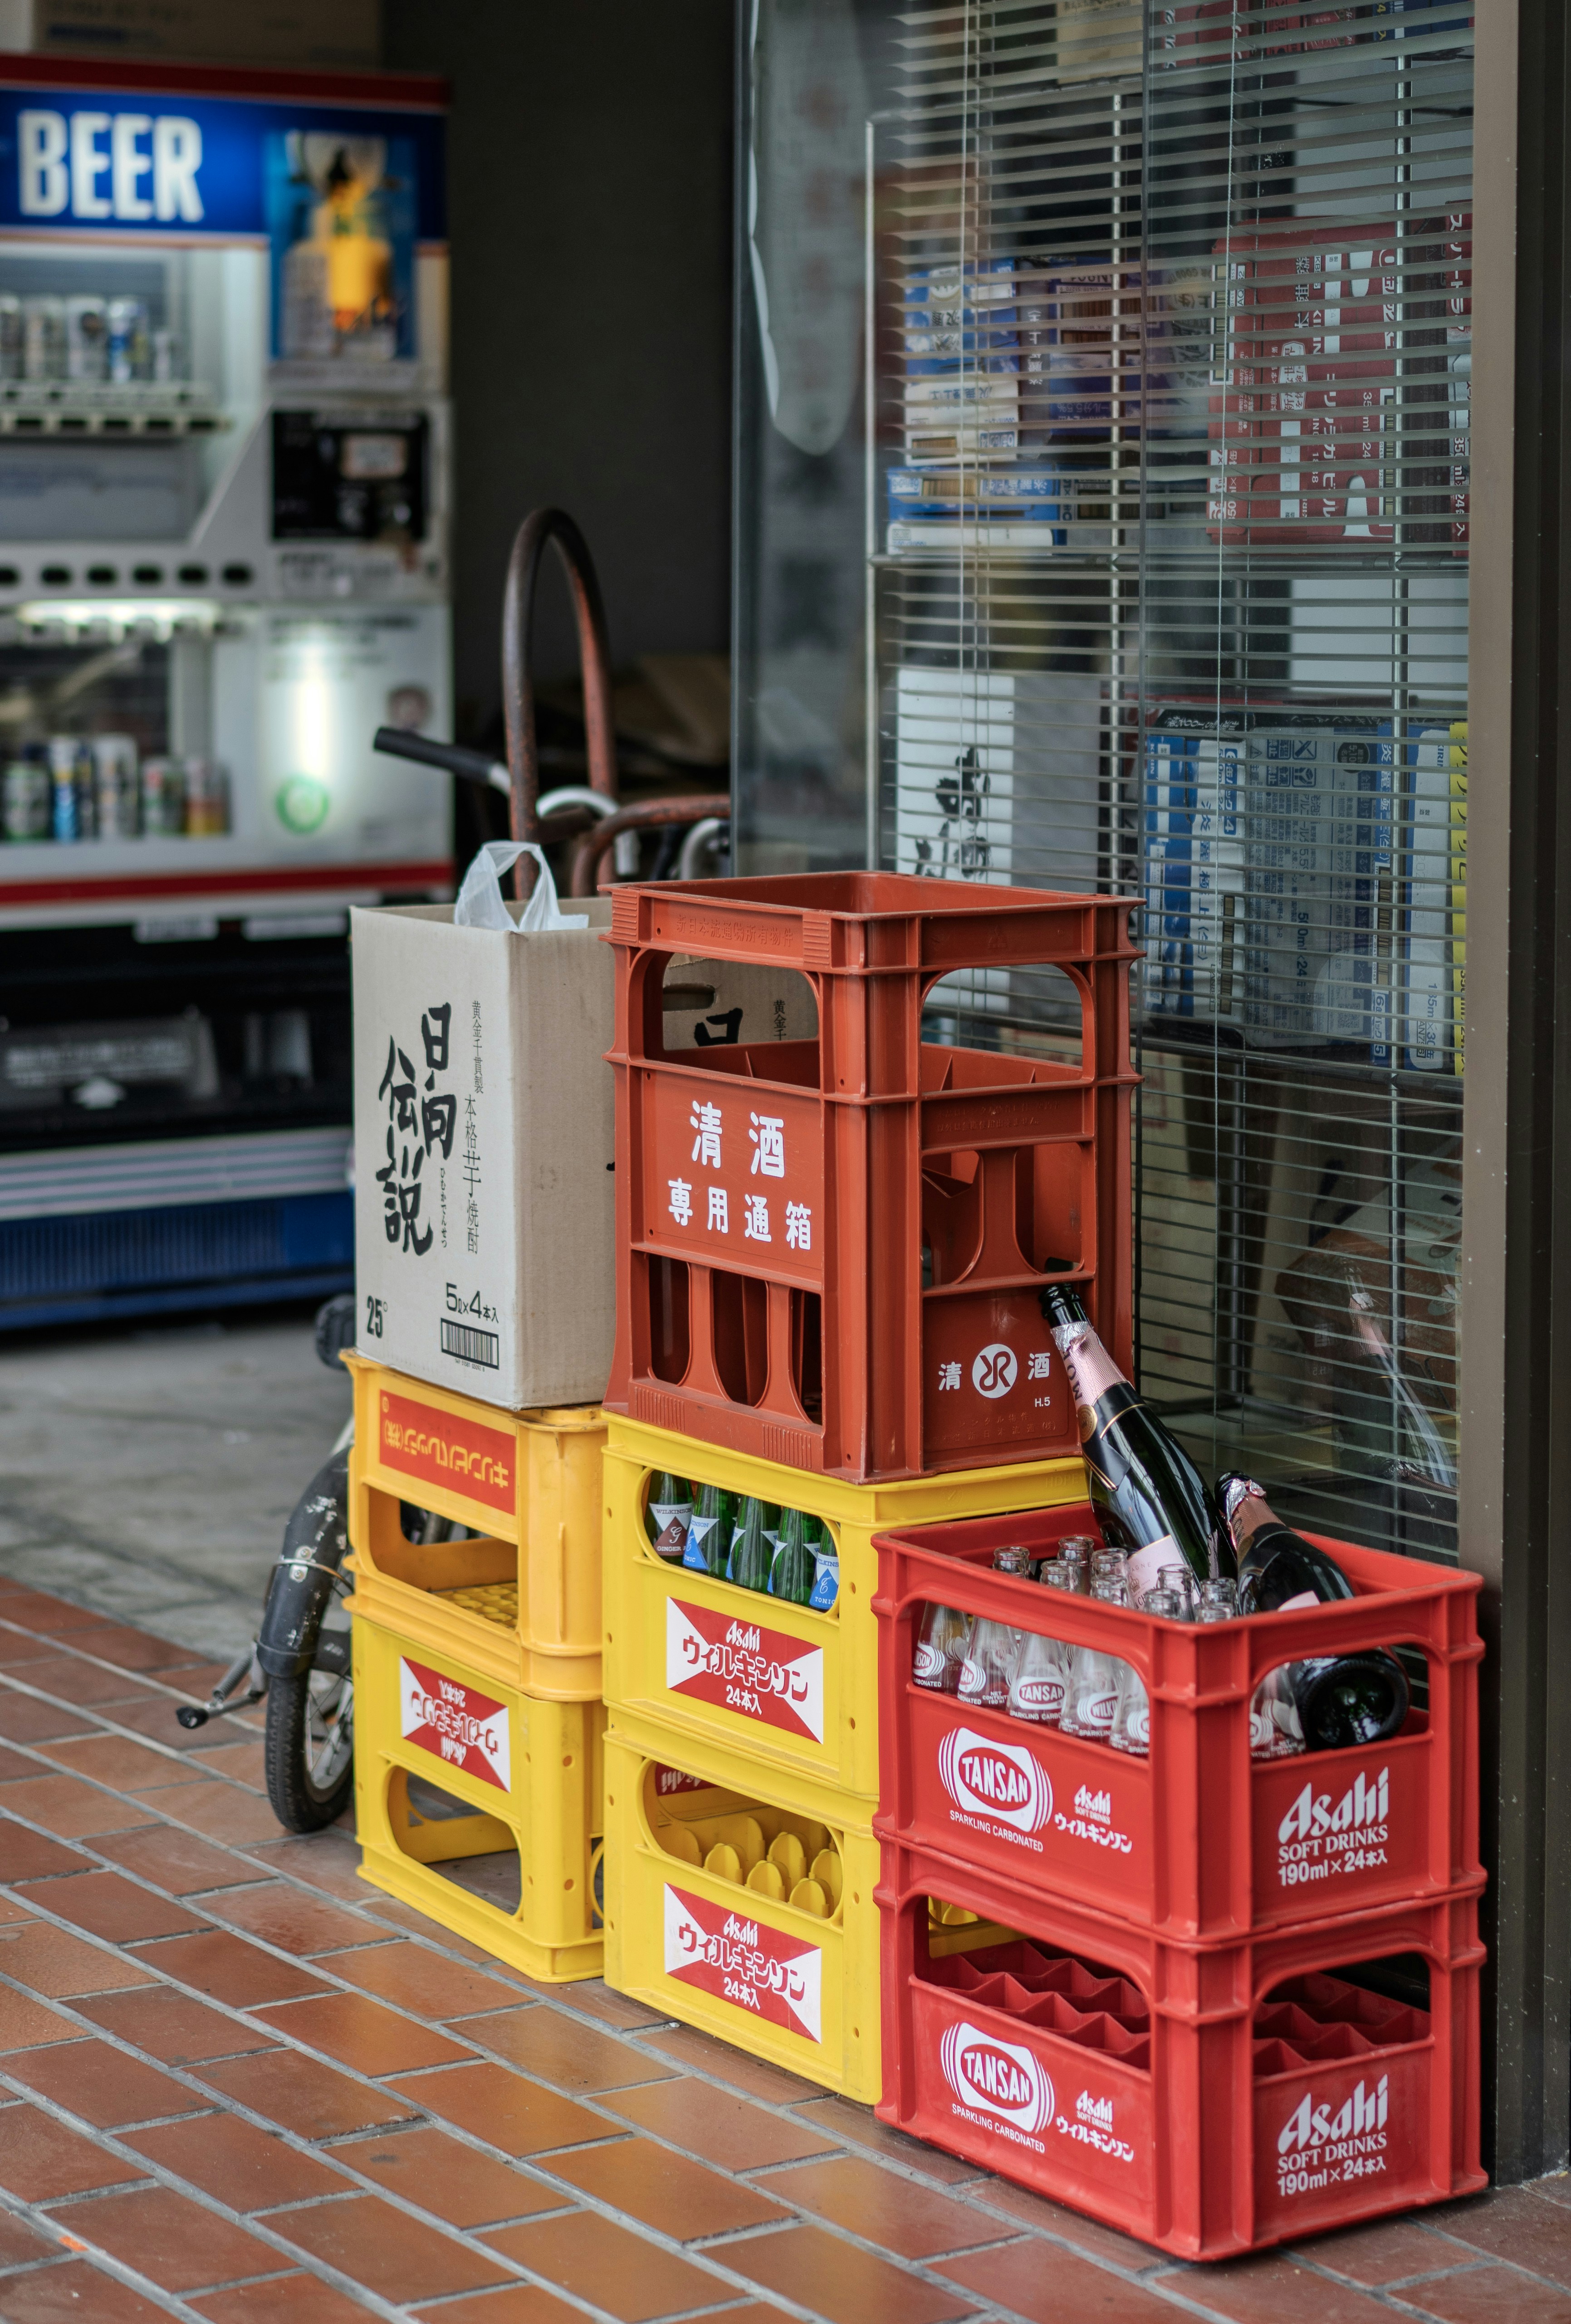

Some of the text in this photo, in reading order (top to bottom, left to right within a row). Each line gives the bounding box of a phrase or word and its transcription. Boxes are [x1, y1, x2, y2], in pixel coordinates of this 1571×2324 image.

[17, 109, 205, 223] BEER
[773, 999, 787, 1041] 黄金千
[472, 1000, 484, 1094] 黄金千貫製
[690, 1100, 785, 1179] 清酒
[463, 1094, 481, 1254] 本格芋焼酎
[668, 1178, 812, 1251] 専用通箱
[1034, 1396, 1051, 1408] H.5
[726, 1620, 761, 1653] Asahi
[682, 1634, 809, 1703] ウィルキンソン
[438, 1679, 466, 1708] 24本入
[726, 1684, 763, 1716] 24本入
[1009, 1709, 1039, 1720] SPARKLING
[1021, 1684, 1064, 1702] TANSAN
[411, 1690, 499, 1756] ウィルキンソン
[962, 1756, 1028, 1803] TANSAN
[1073, 1784, 1111, 1814] Asahi
[1277, 1766, 1389, 1844] Asahi
[949, 1810, 1044, 1853] SPARKLING CARBONATED
[1054, 1812, 1133, 1854] ウィルキンソン
[1278, 1824, 1389, 1864] SOFT DRINKS
[1278, 1848, 1388, 1887] 190ml×24本入
[723, 1913, 759, 1948] Asahi
[678, 1923, 806, 2001] ウィルキンソン
[724, 1977, 761, 2011] 24本入
[964, 2052, 1030, 2103] TANSAN
[1076, 2089, 1112, 2123] Asahi
[1277, 2073, 1388, 2154] Asahi
[952, 2103, 1046, 2154] SPARKLING CARBONATED
[1056, 2116, 1135, 2162] ウィルキンソン
[1277, 2131, 1387, 2174] SOFT DRINKS
[1277, 2155, 1387, 2197] 190ml×24本入
